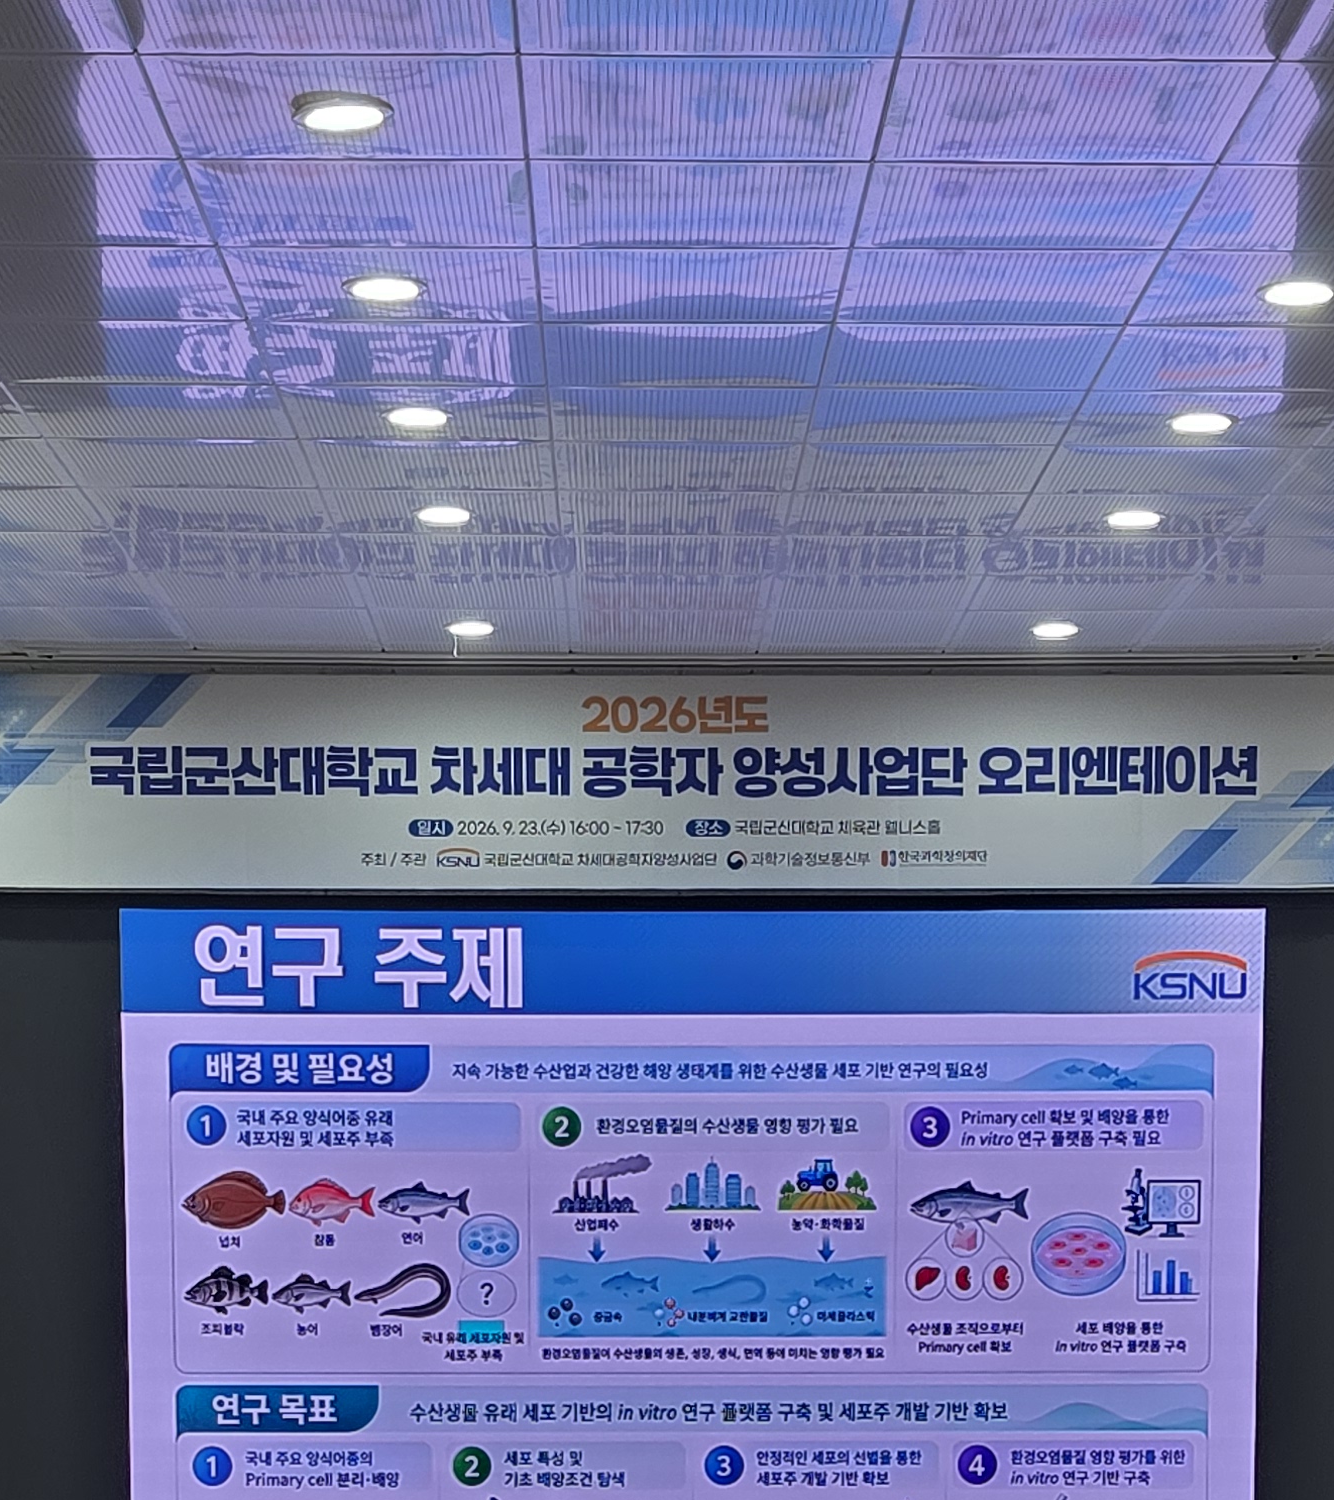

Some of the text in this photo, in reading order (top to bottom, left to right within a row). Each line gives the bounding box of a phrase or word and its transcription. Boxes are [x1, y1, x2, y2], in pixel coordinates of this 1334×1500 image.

[582, 696, 768, 733] 2026년도
[90, 746, 1257, 797] 국립군산대학교 차세대 공학자 양성사업단 오리엔테이션
[414, 819, 449, 837] 일시
[570, 821, 609, 835] 16:00
[626, 821, 663, 835] 17:30
[690, 819, 726, 837] 장소
[736, 820, 833, 835] 국립군산대학교
[838, 821, 880, 835] 체육관
[362, 852, 426, 867] 주최 / 주관
[437, 853, 479, 867] KSNU
[485, 853, 573, 866] 국립군산대학교
[193, 925, 524, 1008] 연구 주제
[1133, 970, 1248, 1001] KSNU
[207, 1052, 392, 1084] 배경 및 필요성
[453, 1062, 987, 1079] 지속 가능한 수산업과 건강한 해양 생태계를 위한 수산생물 세포 기반 연구의 필요성
[201, 1115, 209, 1136] 1
[237, 1110, 392, 1126] 국내 주요 양식어종 유래
[555, 1116, 569, 1137] 2
[597, 1118, 697, 1134] 환경오염물질의
[703, 1118, 759, 1134] 수산생물
[797, 1118, 825, 1134] 평가
[830, 1118, 858, 1134] 필요
[962, 1109, 1169, 1127] Primary cell 확보 및 배양을 통한
[923, 1117, 937, 1138] 3
[238, 1131, 393, 1147] 세포자원 및 세포주 부족
[961, 1130, 1160, 1147] in vitro 연구 플랫폼 구축 필요
[481, 1283, 493, 1305] ?
[919, 1342, 964, 1355] Primary
[967, 1341, 986, 1352] cell
[1070, 1341, 1097, 1352] vitro
[213, 1394, 337, 1424] 연구 목표
[410, 1402, 1007, 1422] 수산생물 유래 세포 기반의 in vitro 연구 플랫폼 구축 및 세포주 개발 기반 확보
[207, 1456, 215, 1476] 1
[246, 1452, 372, 1466] 국내 주요 양식어종의
[505, 1451, 582, 1466] 세포 특성 및
[717, 1456, 731, 1476] 3
[812, 1451, 849, 1465] 세포의
[896, 1451, 921, 1465] 통한
[969, 1455, 985, 1476] 4
[1012, 1450, 1185, 1465] 환경오염물질 영향 평가를 위한
[465, 1456, 479, 1477] 2
[246, 1473, 304, 1489] Primary
[308, 1473, 332, 1486] cell
[505, 1472, 624, 1487] 기초 배양조건 탐색
[757, 1472, 889, 1486] 세포주 개발 기반 확보
[1011, 1470, 1150, 1485] in vitro 연구 기반 구축
